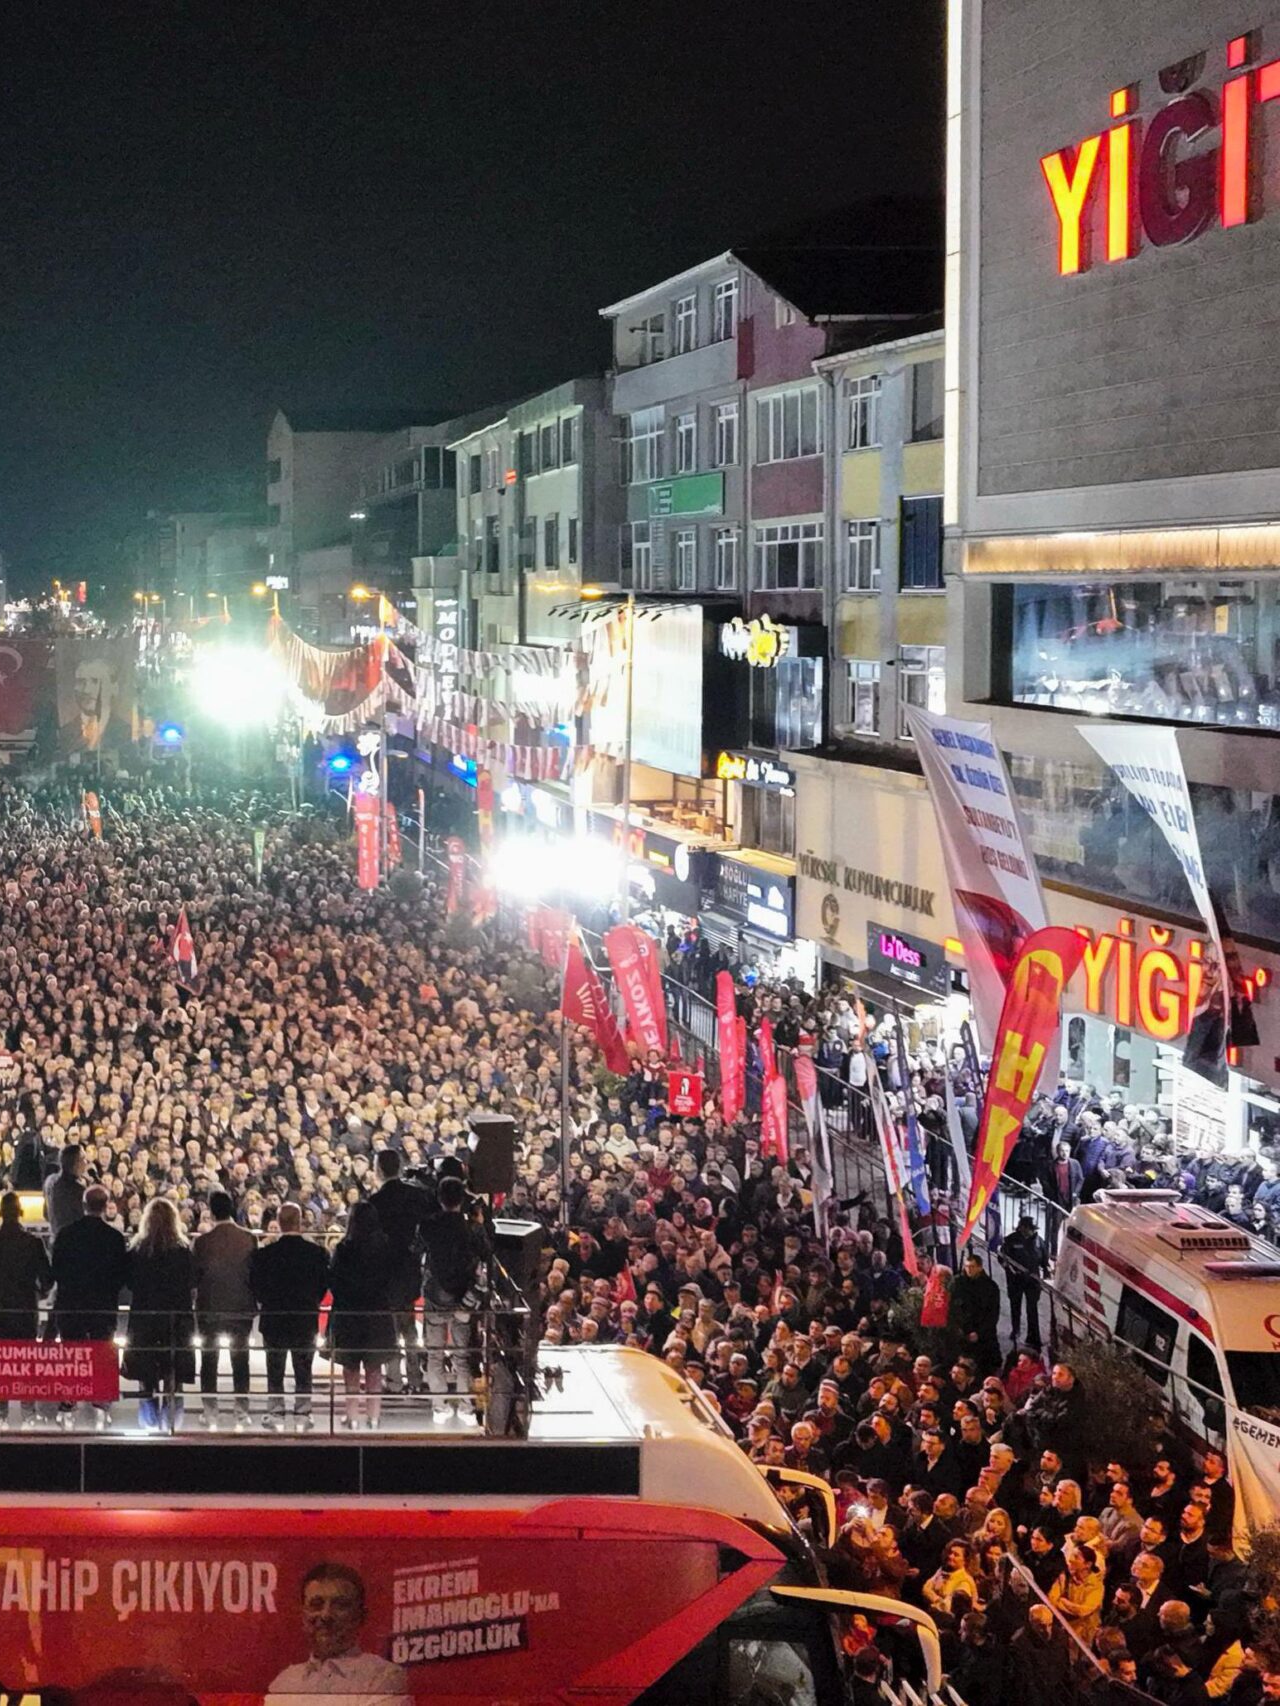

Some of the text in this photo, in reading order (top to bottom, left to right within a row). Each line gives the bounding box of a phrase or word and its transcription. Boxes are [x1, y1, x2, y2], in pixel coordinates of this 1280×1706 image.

[35, 1360, 93, 1377] PARTİSİ
[12, 1381, 51, 1395] Birinci
[54, 1381, 93, 1396] Partisi
[112, 1559, 278, 1623] ÇIKIYOR
[393, 1569, 479, 1605] EKREM
[392, 1622, 521, 1665] ÖZGÜRLÜK
